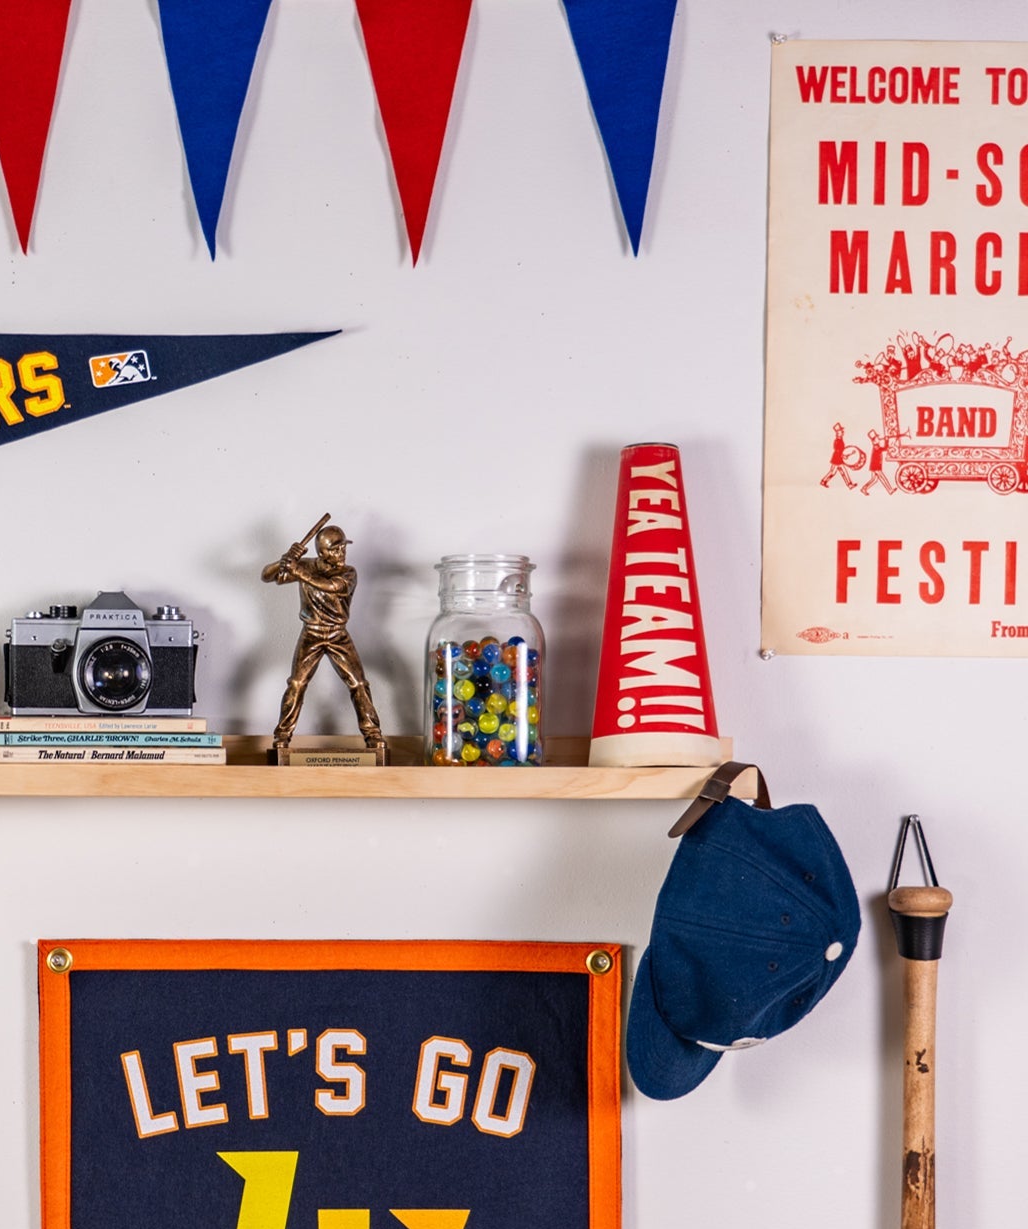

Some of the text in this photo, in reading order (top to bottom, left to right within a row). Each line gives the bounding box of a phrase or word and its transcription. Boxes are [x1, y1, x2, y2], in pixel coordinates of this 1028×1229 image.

[795, 66, 1028, 106] WELCOME TO
[817, 141, 1028, 207] MID-S
[829, 229, 1028, 296] MARC
[915, 405, 998, 440] BAND
[615, 460, 707, 734] YEA TEAM!!
[835, 539, 1017, 606] FESTI
[990, 620, 1028, 638] From
[17, 735, 42, 743] Strike
[43, 735, 66, 743] Three,
[67, 735, 104, 743] CHARLIE
[104, 735, 140, 743] BROWN!
[38, 750, 166, 760] The Natural Bernard Malamud
[119, 1028, 538, 1139] LET'S GO
